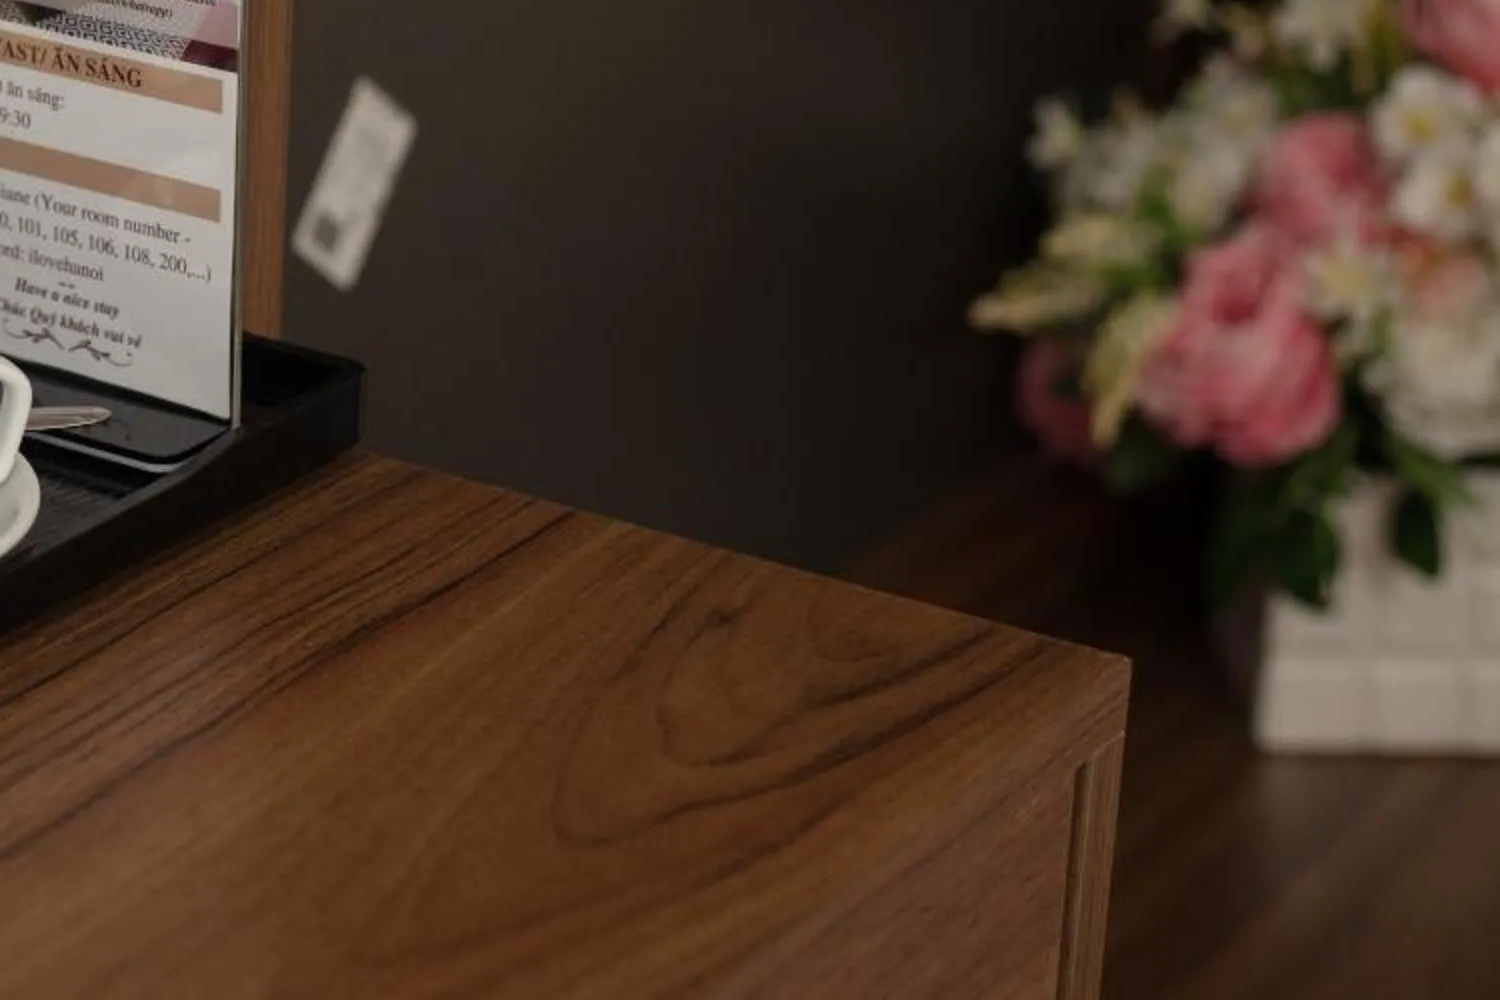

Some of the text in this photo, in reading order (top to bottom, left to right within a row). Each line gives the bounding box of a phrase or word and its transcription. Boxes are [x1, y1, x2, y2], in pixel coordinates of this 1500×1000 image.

[0, 107, 32, 130] 9:30
[34, 191, 78, 219] (Your
[81, 208, 120, 229] room
[124, 216, 181, 245] number
[18, 216, 47, 240] 101,
[53, 225, 83, 249] 105,
[89, 234, 119, 259] 106,
[124, 243, 154, 268] 108,
[28, 247, 104, 282] ilovehanoi
[14, 277, 120, 320] Have a nice stay
